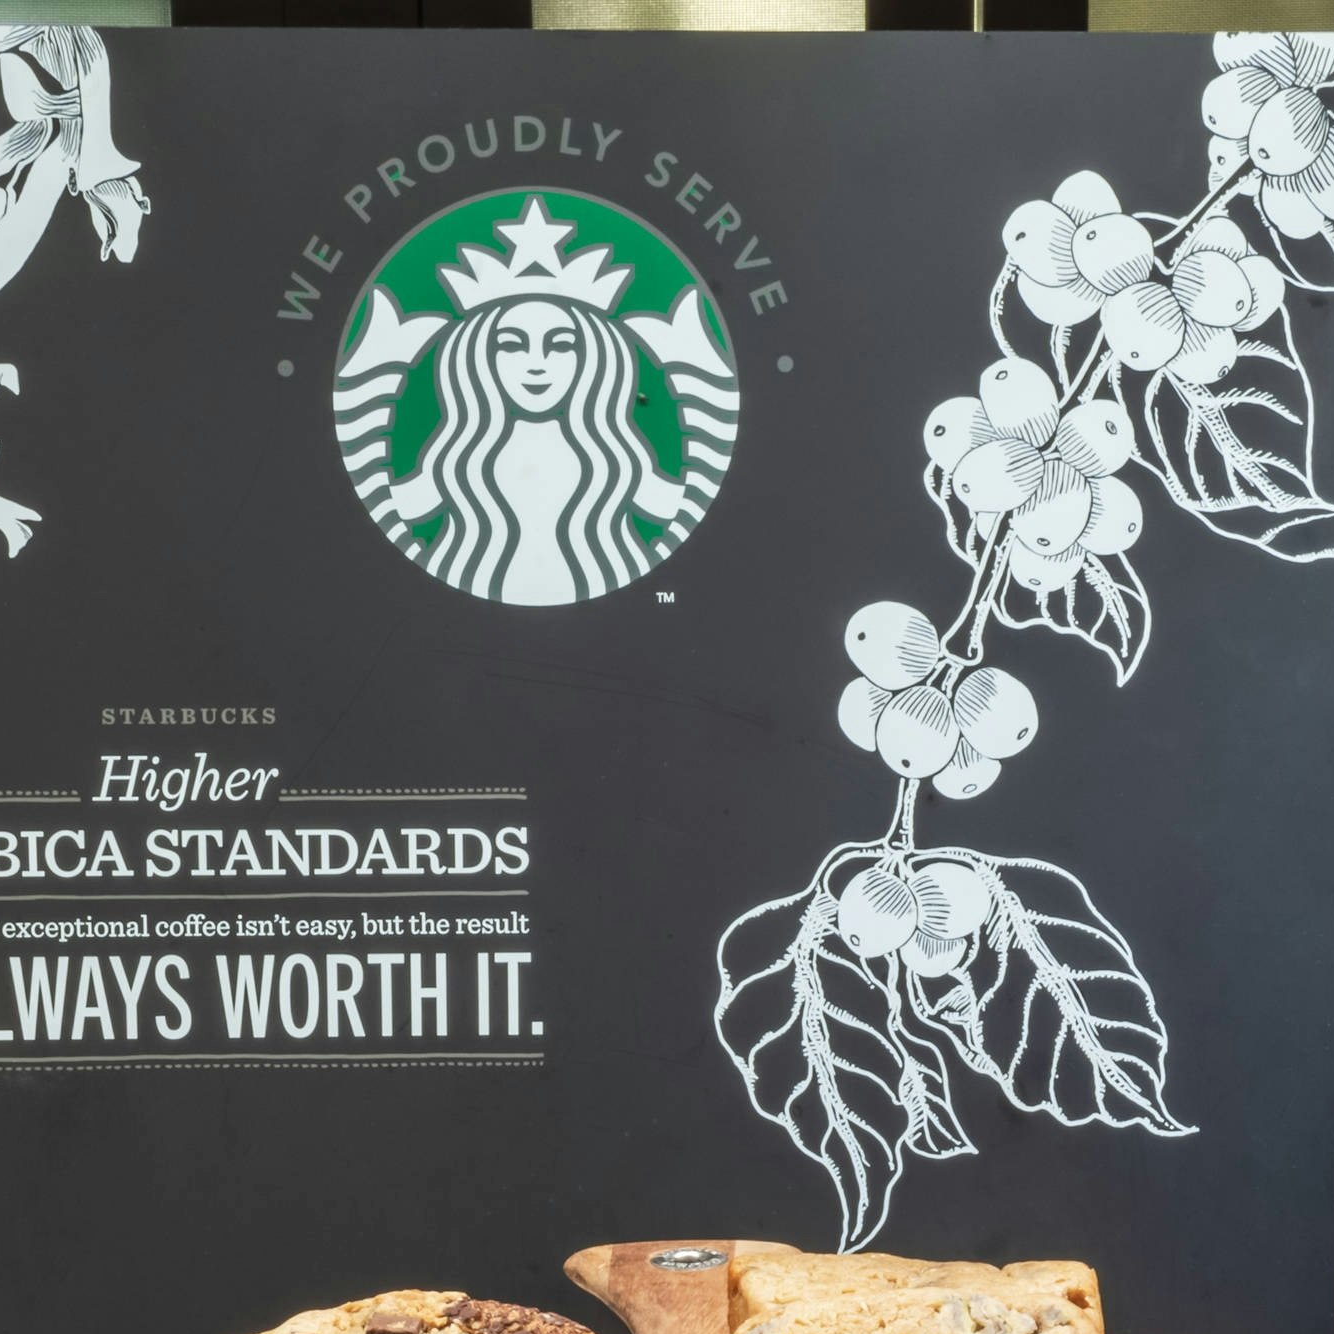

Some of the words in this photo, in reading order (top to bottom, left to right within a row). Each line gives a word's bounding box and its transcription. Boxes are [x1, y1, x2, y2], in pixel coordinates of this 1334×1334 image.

[276, 235, 343, 322] WE
[344, 114, 623, 222] PROUDLY
[644, 151, 789, 316] SERVE
[100, 707, 278, 726] STARBUCKS
[92, 752, 279, 811] Higher
[145, 826, 530, 877] STANDARDS
[2, 914, 149, 942] exceptional
[155, 914, 229, 938] coffee
[296, 916, 356, 941] easy,
[362, 913, 403, 936] but
[409, 913, 449, 935] the
[456, 912, 529, 934] result
[215, 952, 448, 1039] WORTH
[476, 952, 545, 1036] IT.
